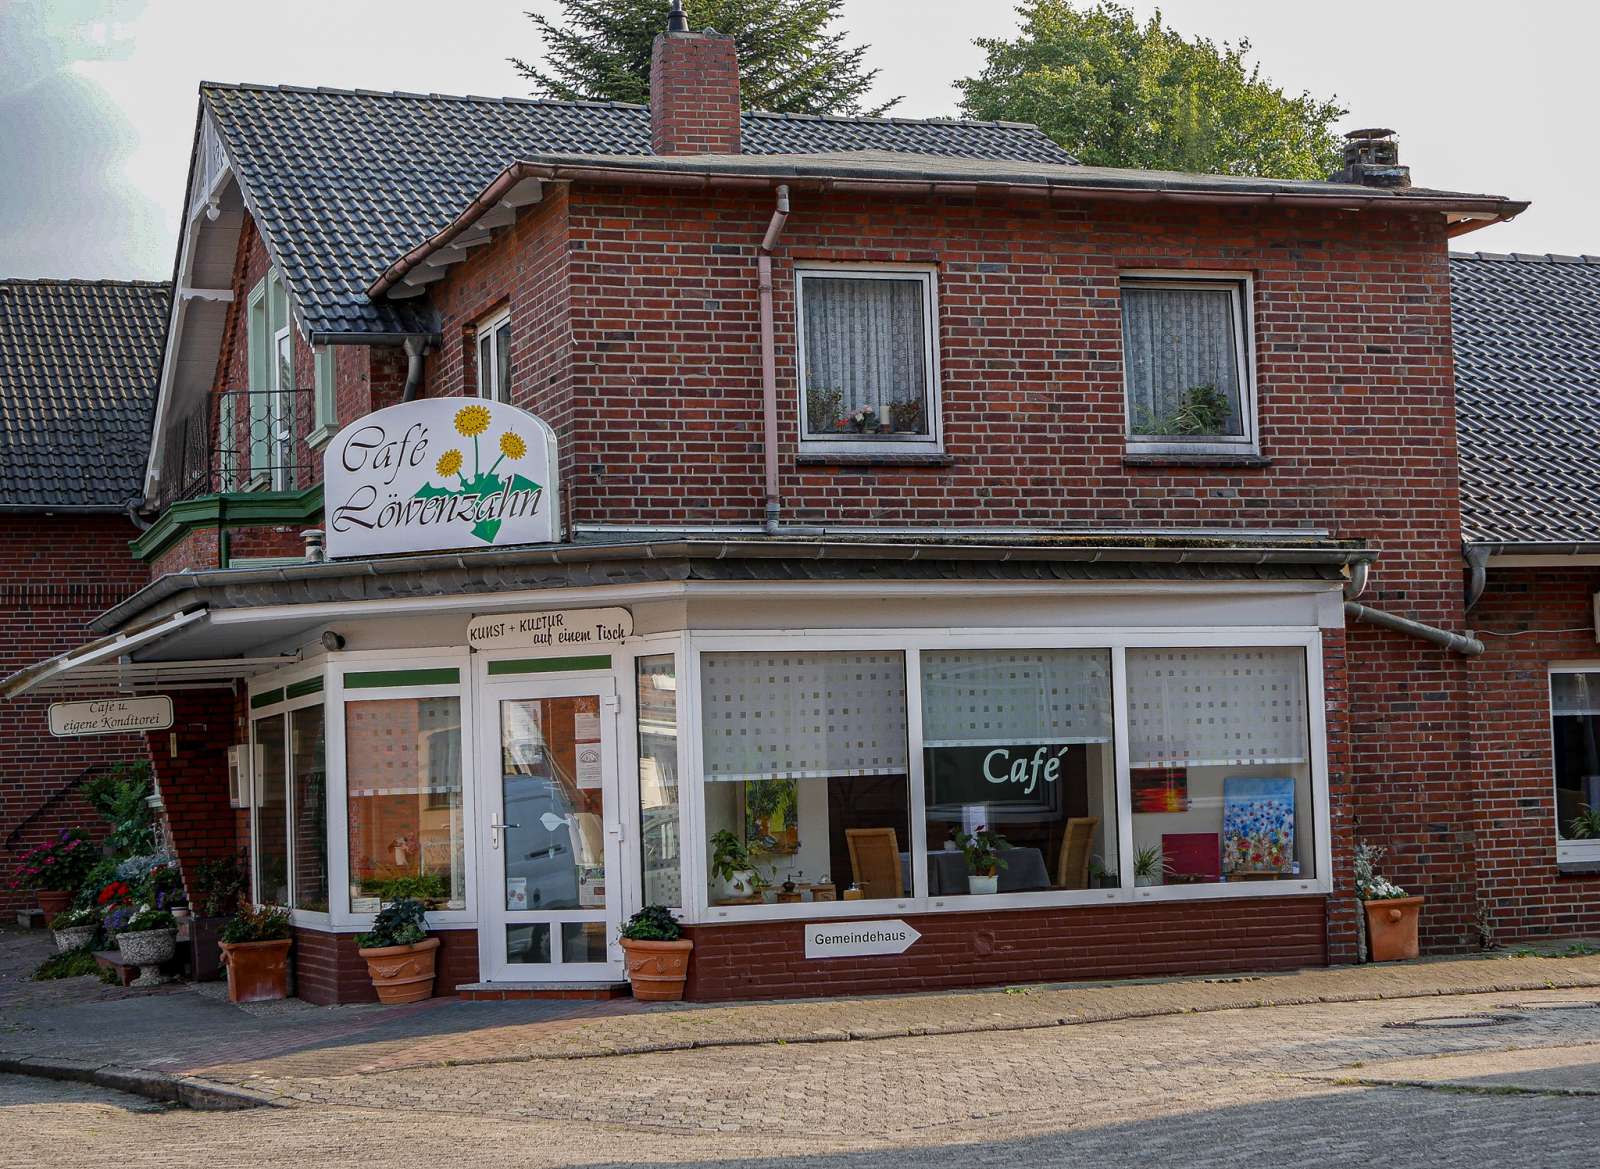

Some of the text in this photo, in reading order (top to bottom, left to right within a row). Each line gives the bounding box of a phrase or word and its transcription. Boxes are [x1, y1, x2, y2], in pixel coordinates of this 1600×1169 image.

[342, 422, 430, 485] Café
[331, 473, 543, 532] Löwenzahn
[470, 624, 505, 641] KUNST
[520, 613, 564, 632] KULTUR
[533, 624, 625, 646] auf einem Tisch
[118, 702, 128, 711] u.
[63, 712, 160, 734] eigene Konditorei
[983, 746, 1069, 794] Café
[815, 931, 906, 945] Gemeindehaus
